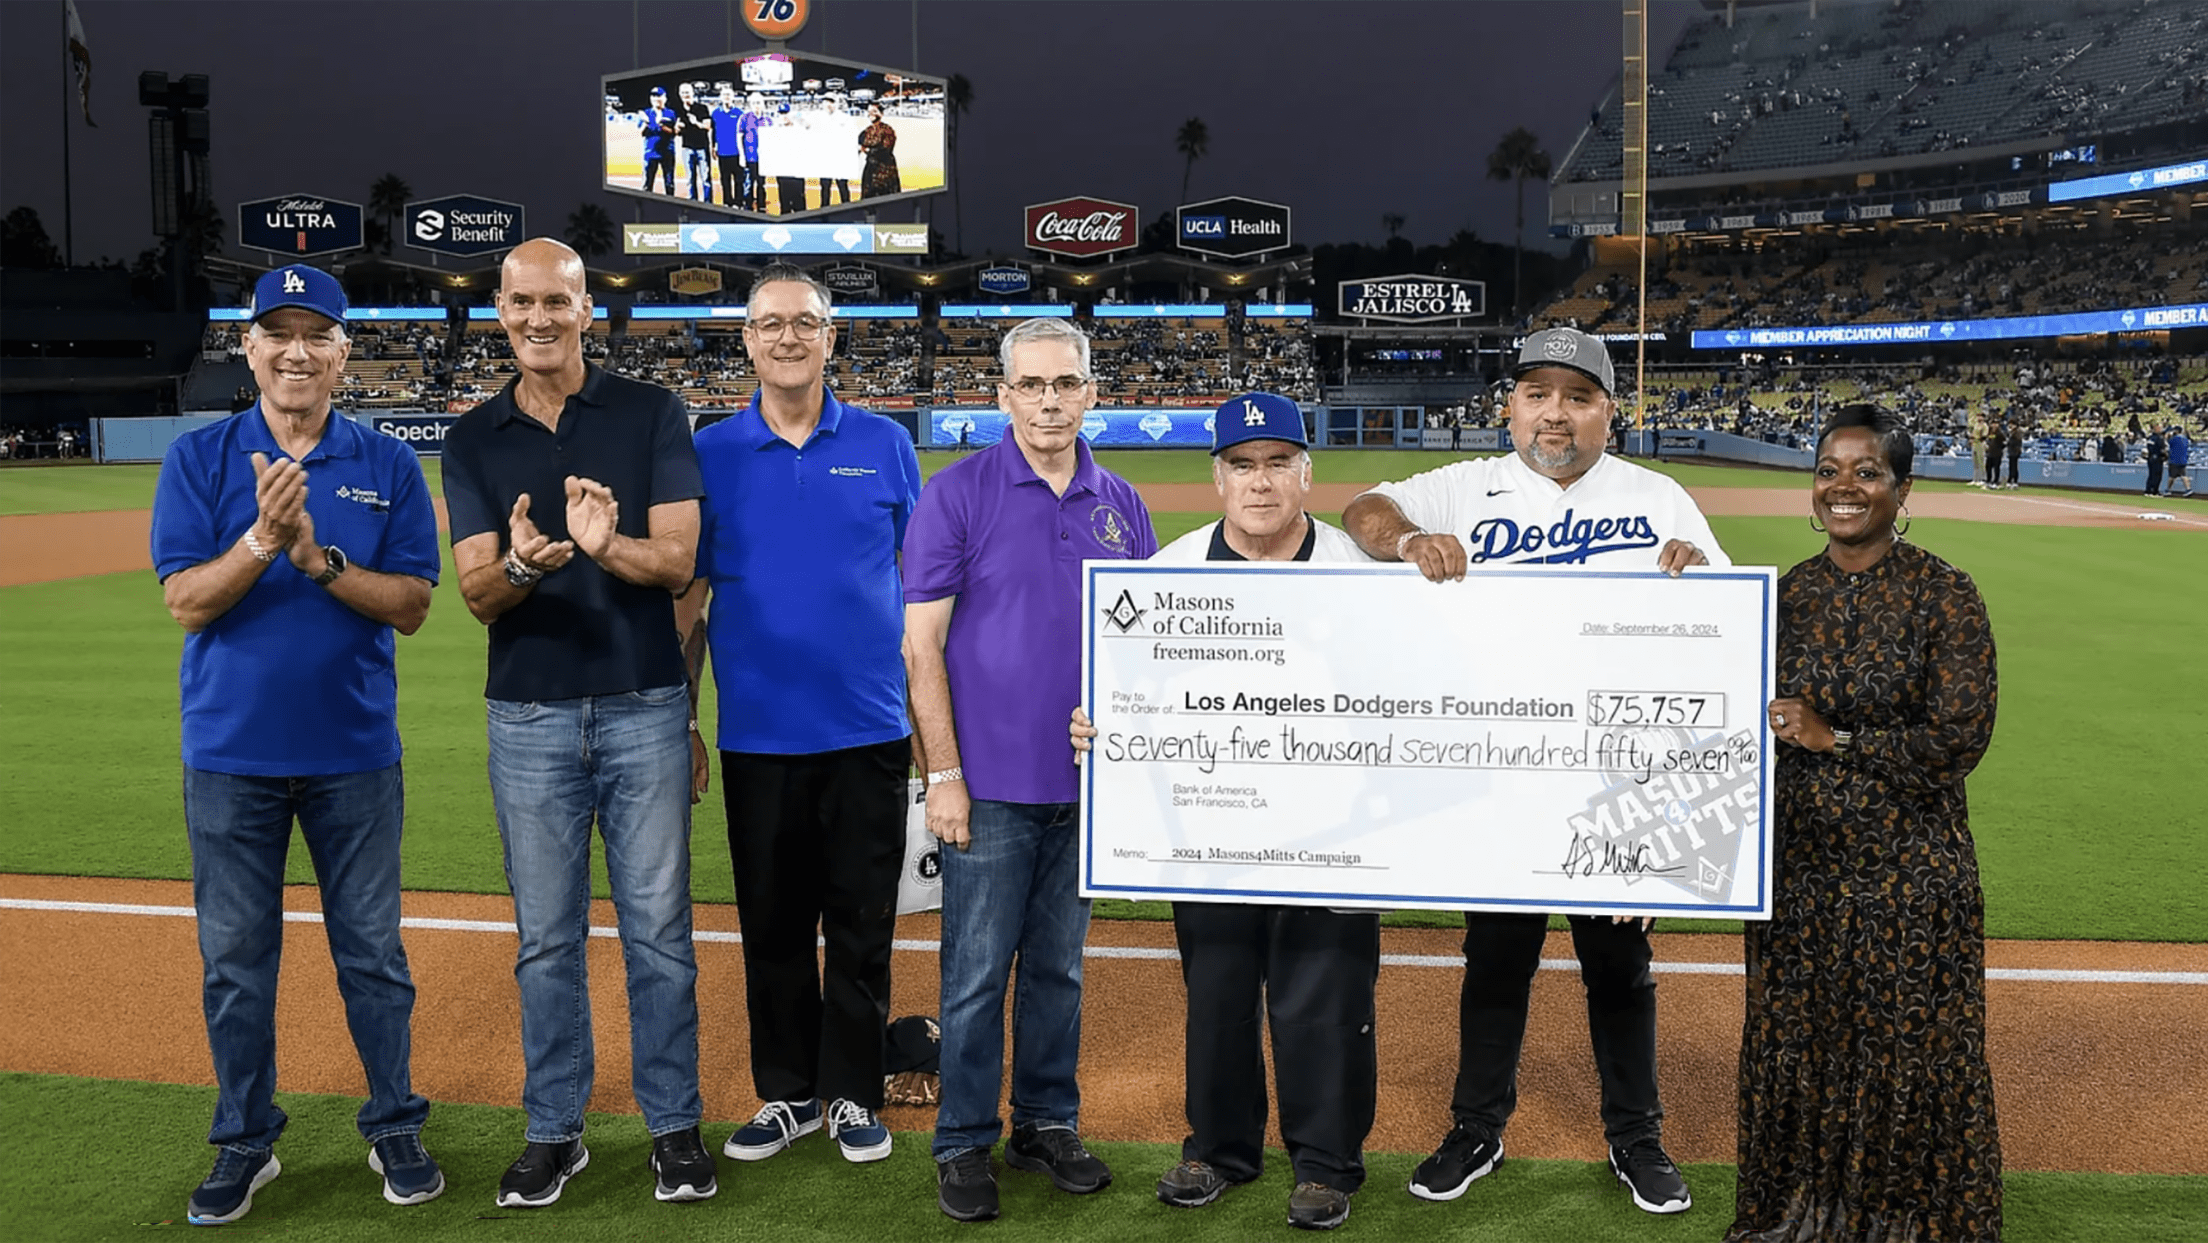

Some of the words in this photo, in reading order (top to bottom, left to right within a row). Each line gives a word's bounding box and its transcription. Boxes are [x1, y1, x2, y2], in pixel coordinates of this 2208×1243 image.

[754, 0, 797, 22] 76
[2154, 164, 2206, 184] MEMBER
[266, 213, 336, 229] ULTRA
[450, 209, 513, 229] Security
[1035, 211, 1128, 242] Coca-Cola
[1186, 220, 1223, 234] UCLA
[1230, 219, 1281, 235] Health
[451, 226, 506, 242] Benefit
[283, 269, 306, 293] LA
[828, 273, 873, 281] STARLUX
[981, 272, 1027, 283] MORTON
[1363, 283, 1450, 298] ESTREL
[1352, 298, 1446, 314] JALISCO
[2144, 309, 2196, 326] MEMBER
[1607, 333, 1649, 341] FOUNDATIN
[1750, 329, 1805, 344] MEMBER
[1806, 326, 1893, 342] APPRECIATION
[1893, 325, 1931, 339] NIGHT
[1243, 400, 1266, 426] LA
[1471, 508, 1659, 564] Dodgers
[1153, 592, 1235, 612] Masons
[1153, 615, 1176, 635] of
[1179, 615, 1284, 636] California
[1582, 622, 1610, 634] Date:
[1612, 622, 1671, 637] September
[1672, 623, 1689, 636] 26,
[1691, 623, 1719, 635] 2024
[1153, 641, 1286, 666] freemason.org
[1111, 690, 1132, 703] Pay
[1134, 691, 1145, 702] to
[1185, 691, 1225, 711] Los
[1232, 692, 1326, 716] Angeles
[1333, 693, 1434, 718] Dodgers
[1441, 695, 1575, 718] Foundation
[1111, 703, 1128, 714] the
[1130, 703, 1159, 715] Order
[1162, 704, 1176, 715] of:
[1588, 692, 1706, 729] $75,757
[1105, 725, 1271, 774] seventy-five
[1279, 723, 1393, 767] thousand
[1595, 732, 1653, 784] fifty
[1663, 748, 1729, 773] seven
[1172, 783, 1199, 795] Bank
[1202, 784, 1213, 796] of
[1214, 785, 1258, 797] America
[1172, 796, 1194, 807] San
[1195, 796, 1249, 809] Francisco,
[1250, 798, 1268, 809] CA
[1112, 848, 1149, 860] Memo:
[1171, 847, 1202, 860] 2024
[1207, 847, 1296, 863] Masons4Mitts
[1297, 849, 1362, 866] Campaign
